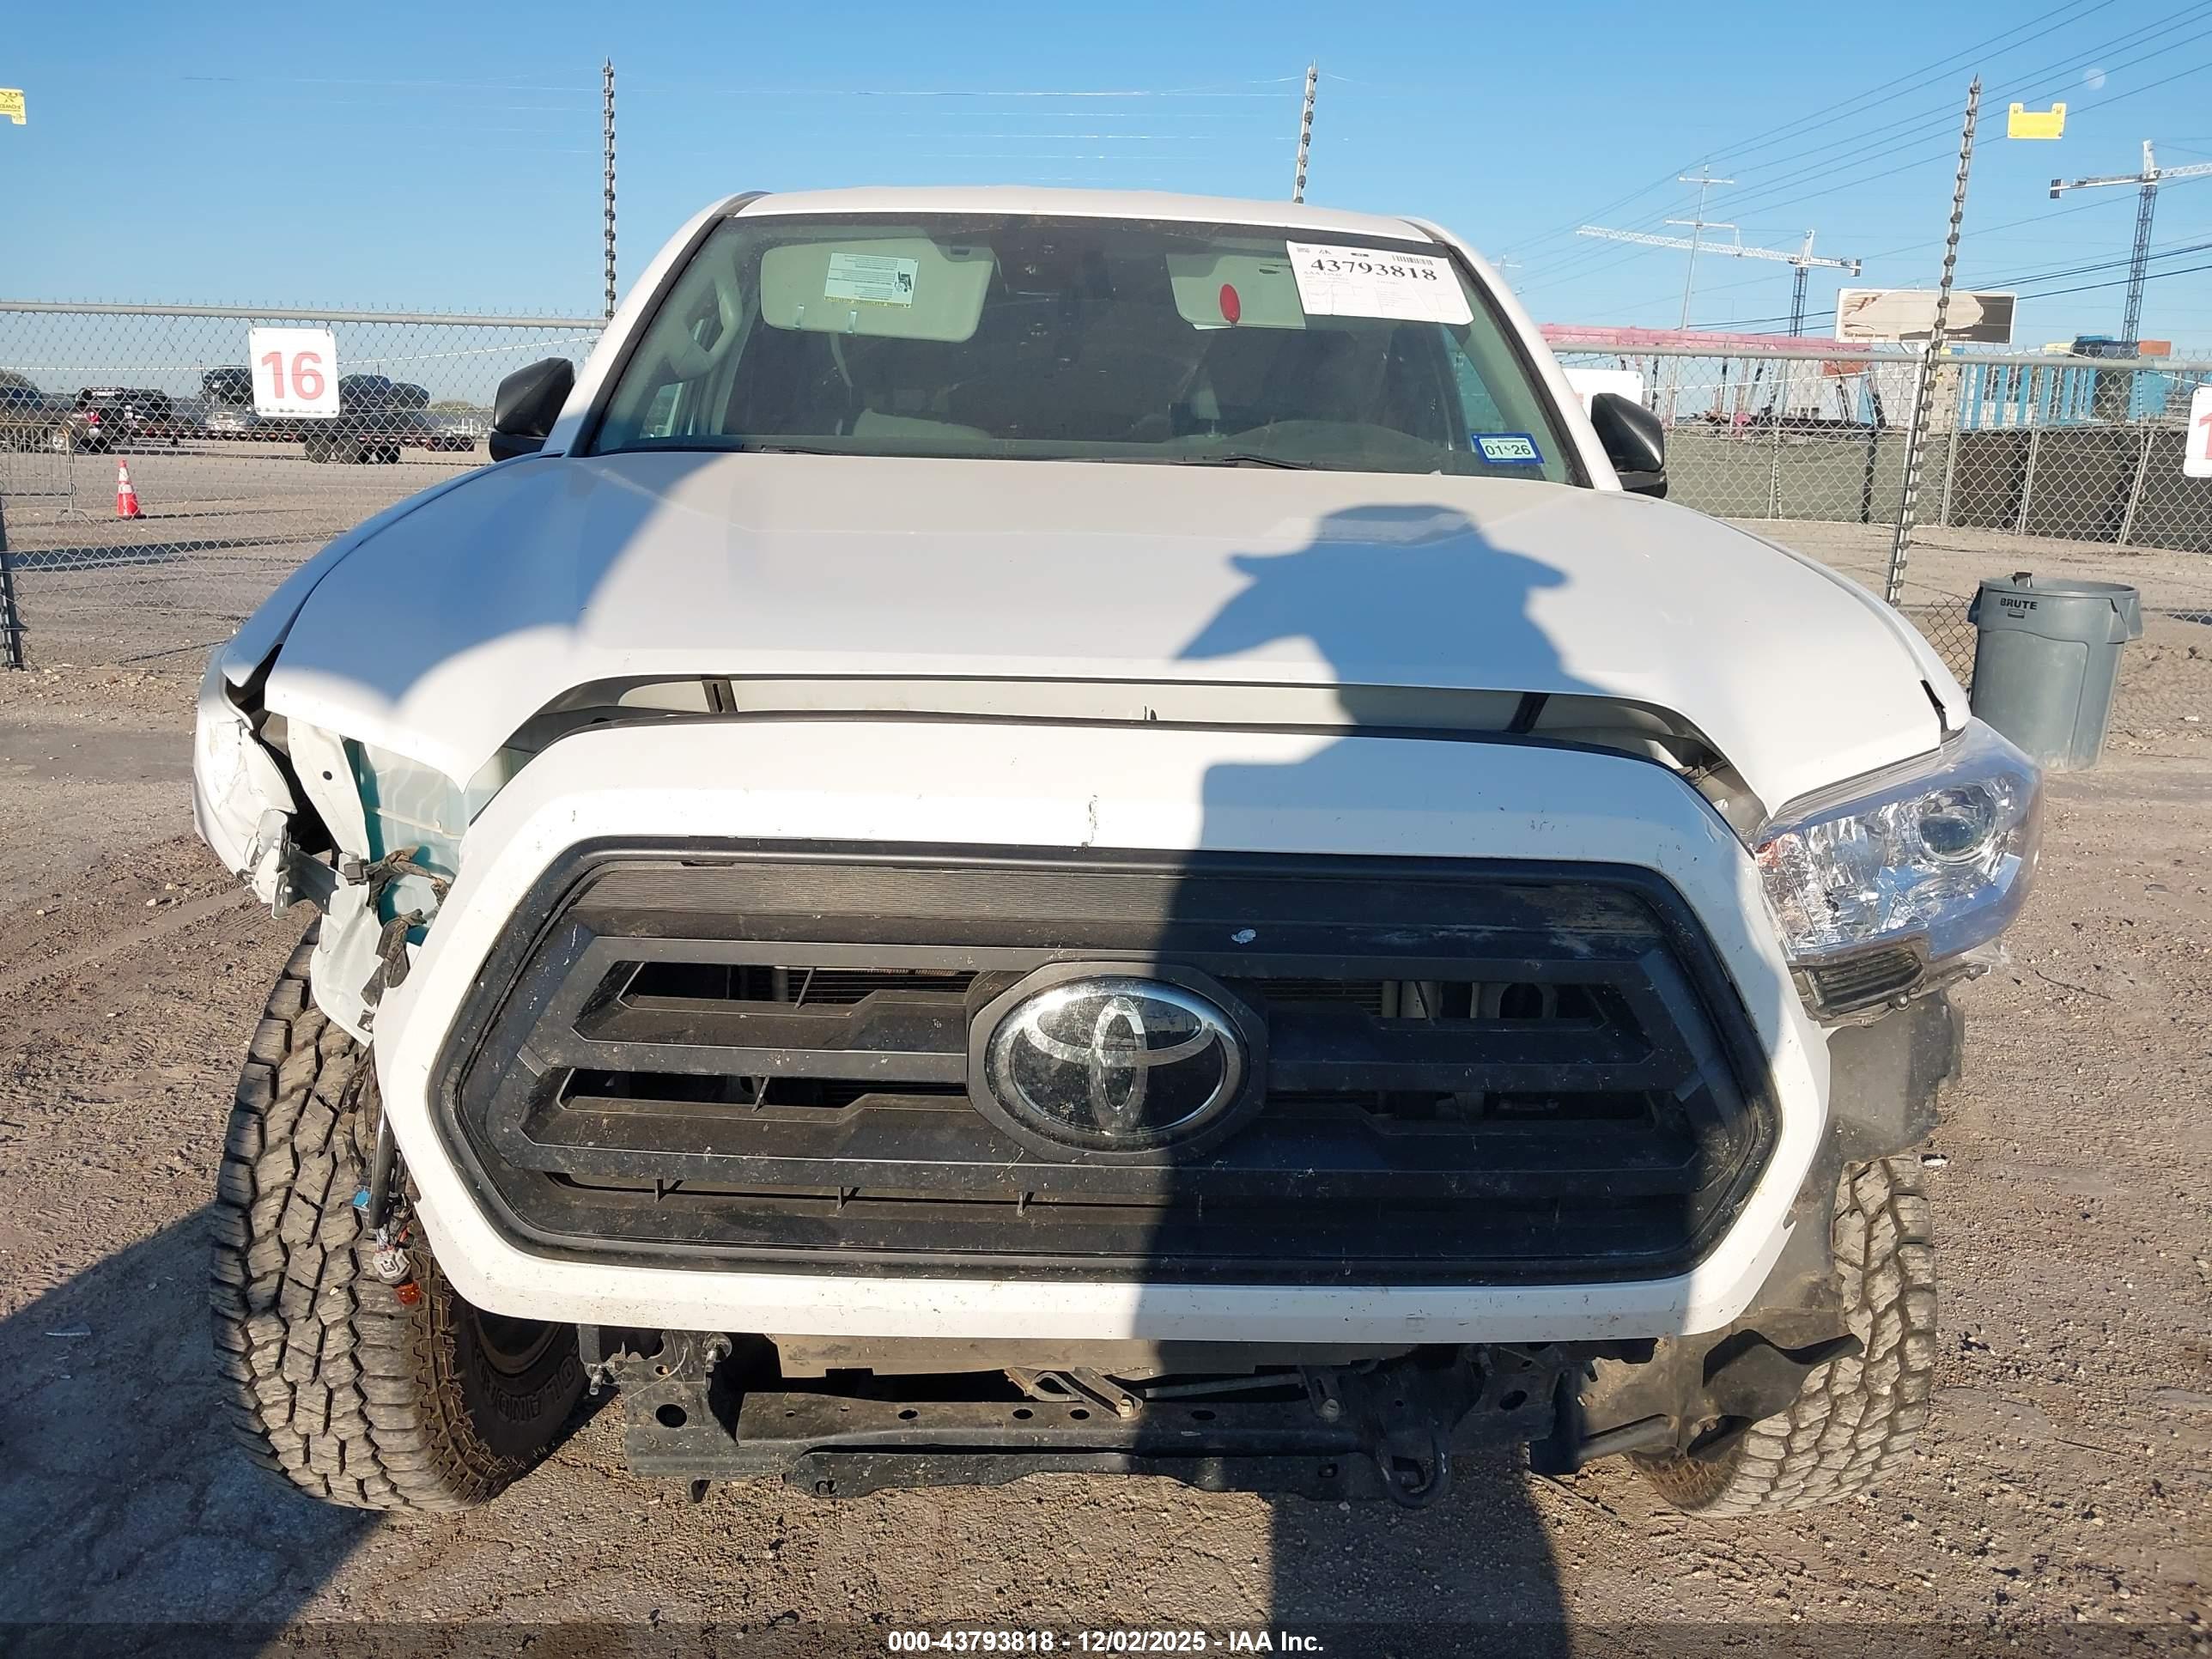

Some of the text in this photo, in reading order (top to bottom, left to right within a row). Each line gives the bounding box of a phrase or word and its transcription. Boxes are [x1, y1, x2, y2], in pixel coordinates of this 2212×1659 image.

[1310, 258, 1437, 281] 43793818
[261, 350, 325, 400] 16
[1486, 445, 1531, 455] 01 26
[2000, 598, 2038, 611] BRUTE
